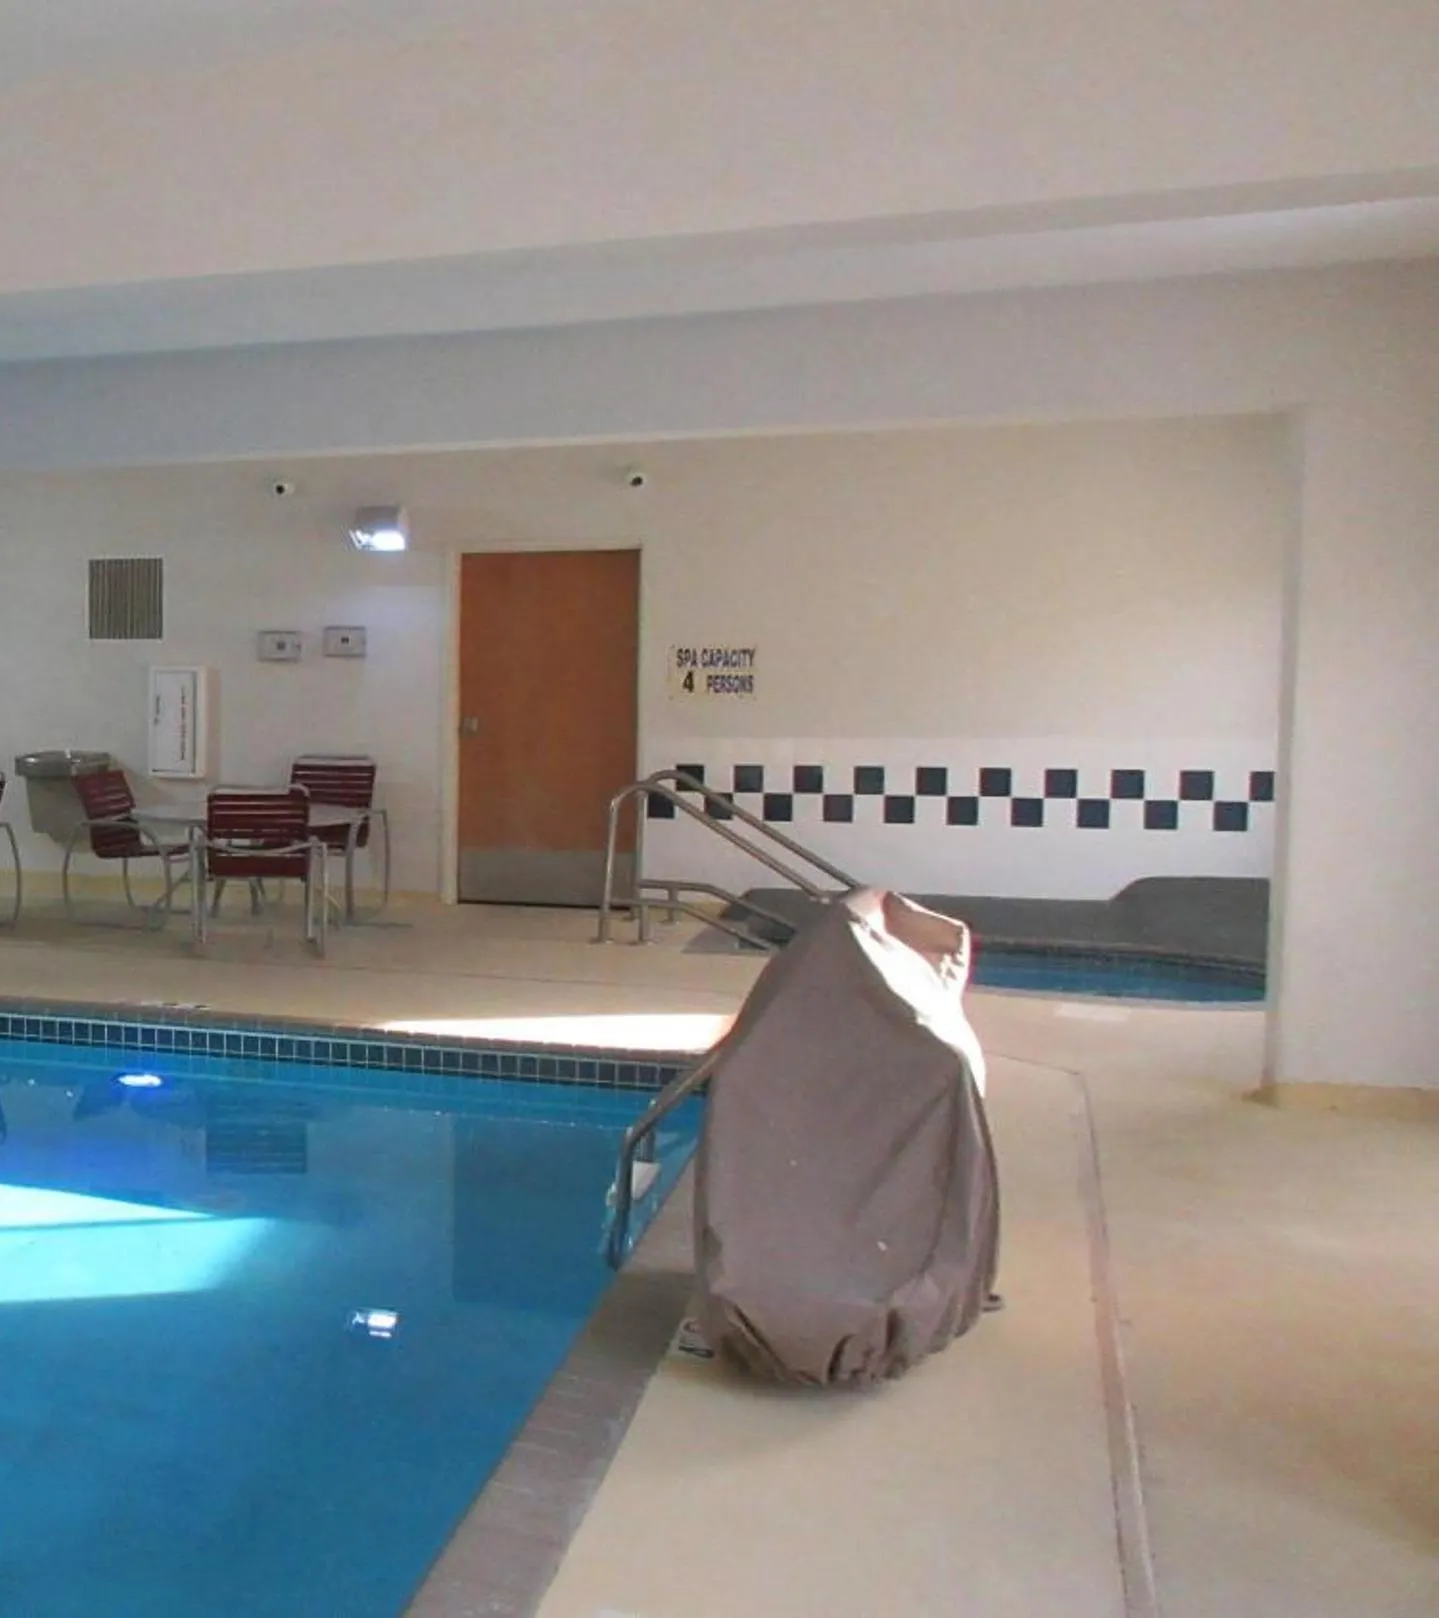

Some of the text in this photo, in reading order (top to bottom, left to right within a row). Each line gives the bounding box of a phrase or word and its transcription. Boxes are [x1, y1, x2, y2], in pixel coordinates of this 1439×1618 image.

[676, 648, 755, 668] SPA CAPACITY
[682, 671, 754, 694] 4 PERSONS
